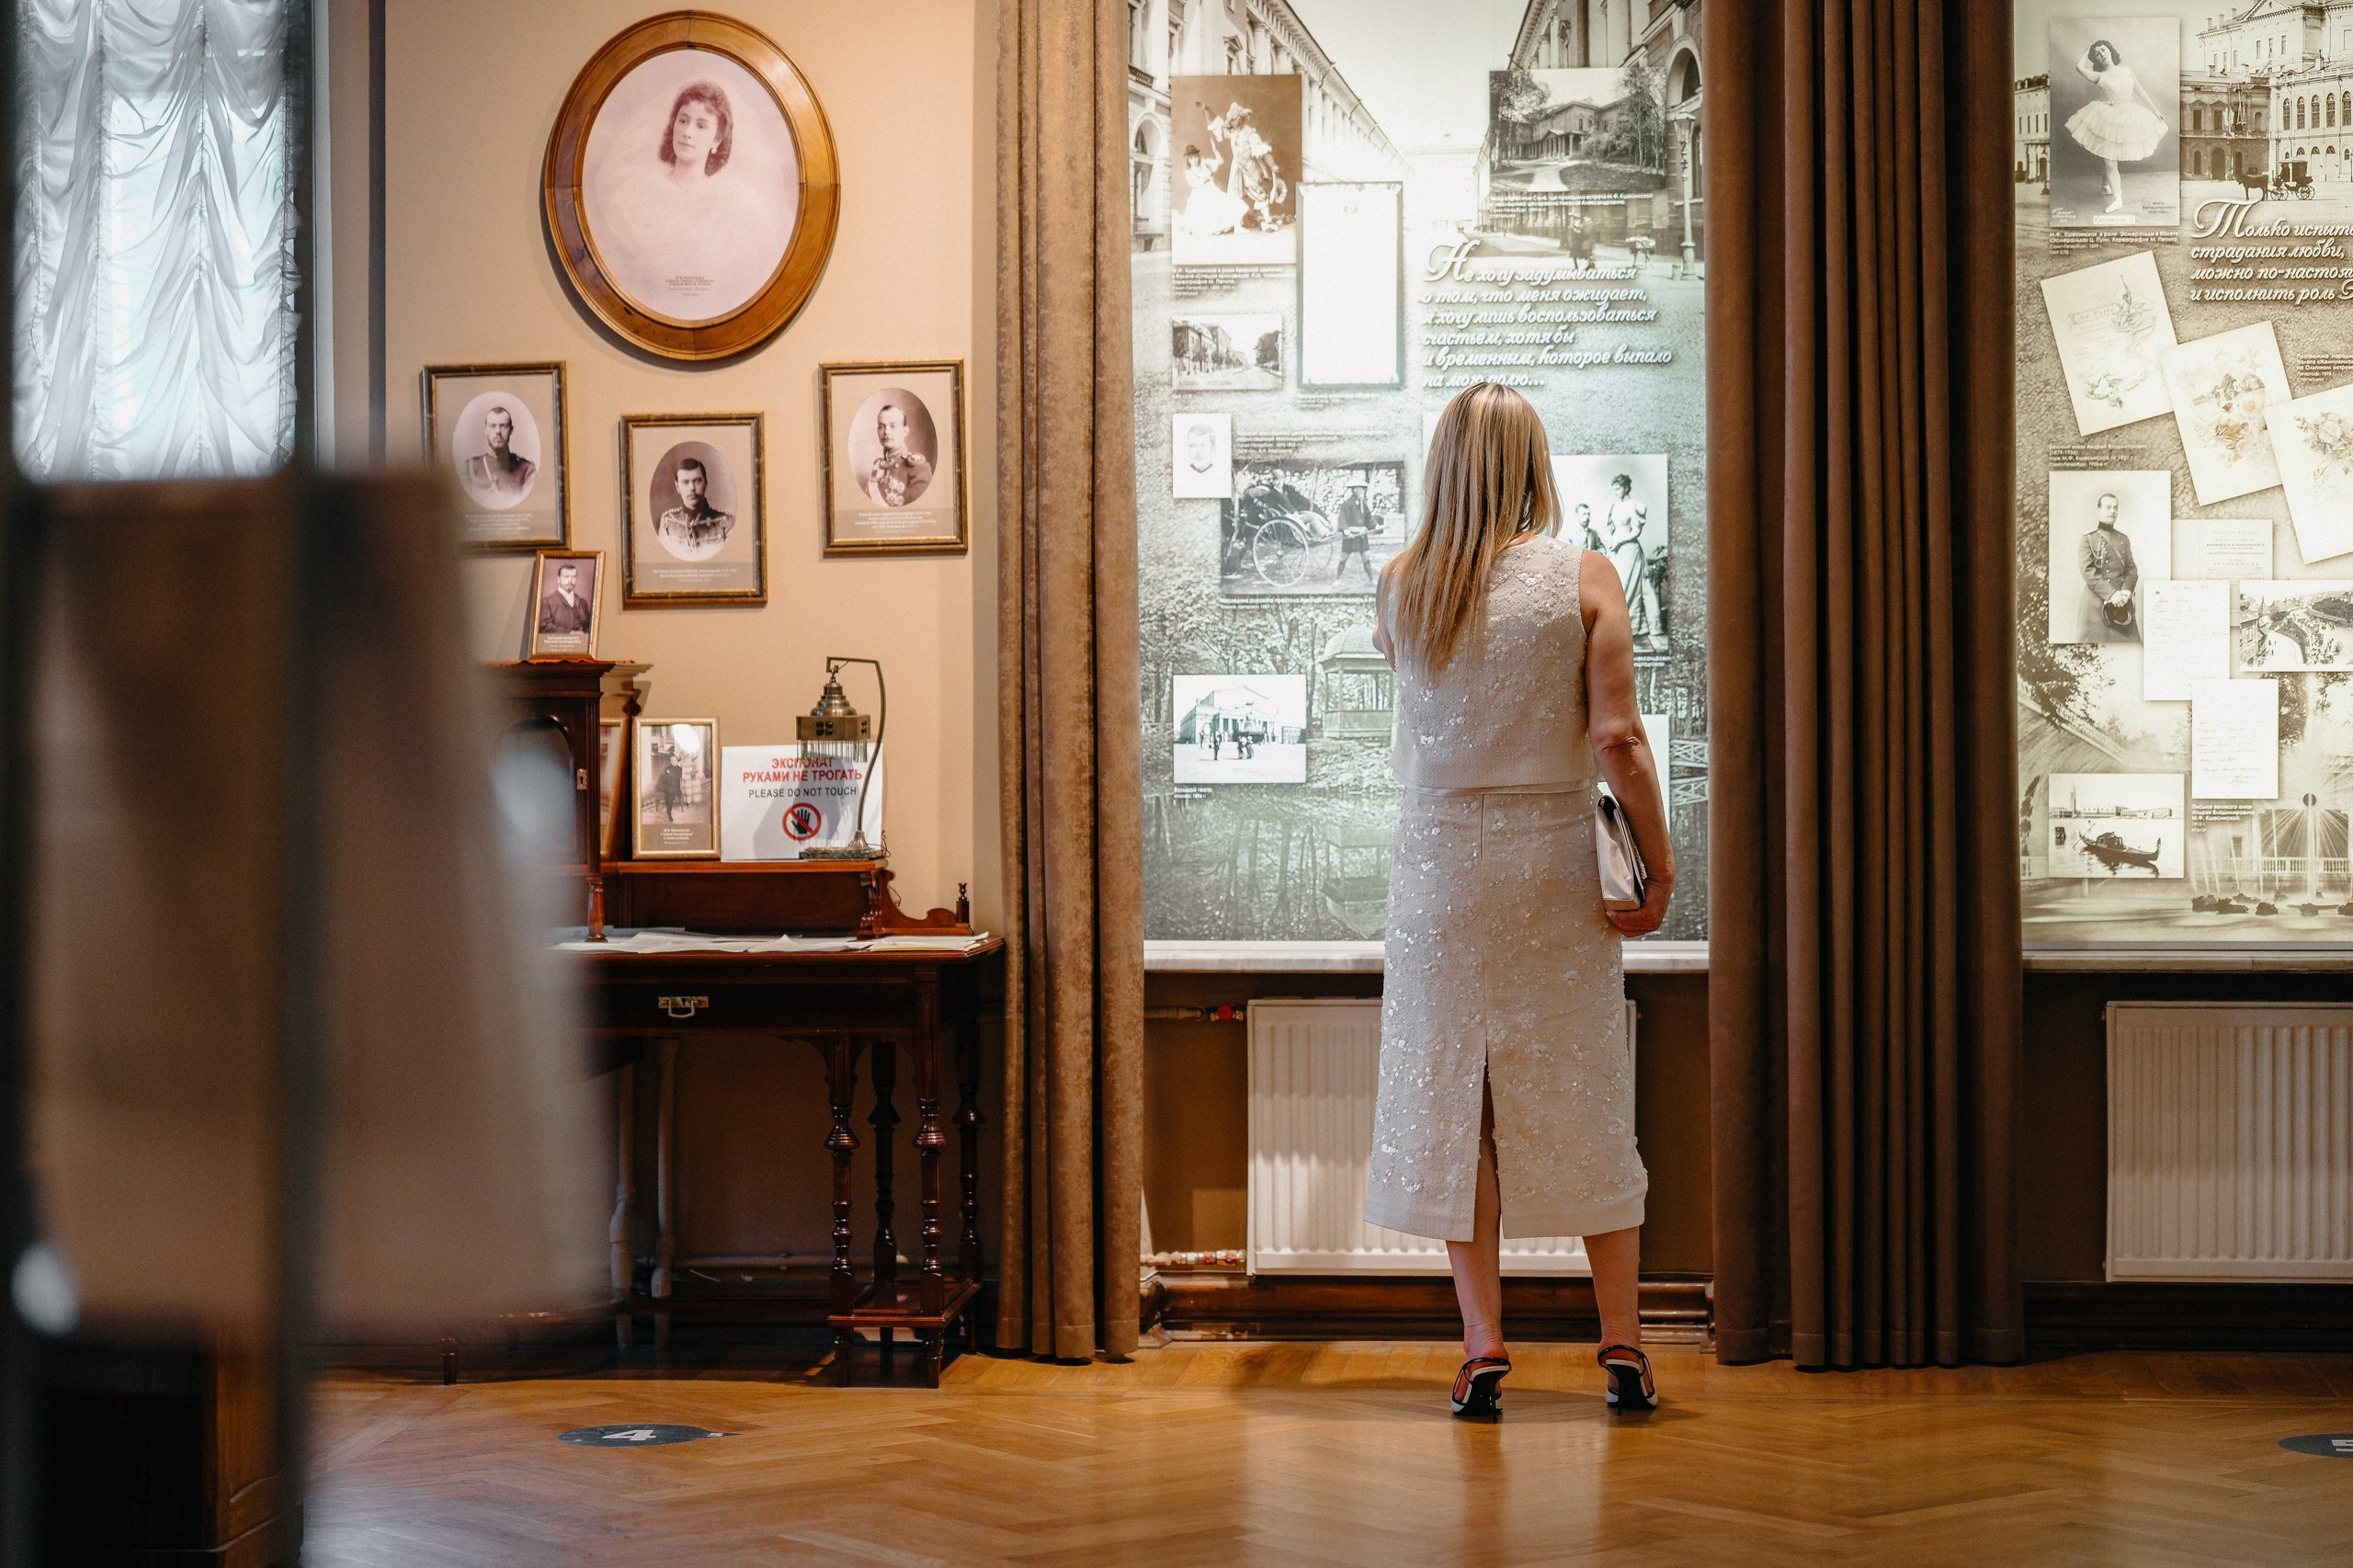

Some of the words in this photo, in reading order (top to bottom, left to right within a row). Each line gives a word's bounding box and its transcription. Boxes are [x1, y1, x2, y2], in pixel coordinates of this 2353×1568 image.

[2191, 198, 2290, 238] Только
[2191, 245, 2288, 264] страдания
[2289, 237, 2345, 259] любви,
[1424, 240, 1480, 282] Не
[1516, 265, 1638, 287] задумываться
[2191, 267, 2254, 279] можно
[1436, 291, 1478, 307] том,
[1517, 290, 1561, 303] меня
[1563, 289, 1647, 306] ожидает,
[2190, 289, 2201, 301] и
[2205, 288, 2295, 301] исполнить
[2297, 288, 2336, 305] роль
[1518, 304, 1656, 324] воспользоваться
[1506, 329, 1551, 346] хотя
[1554, 324, 1574, 345] бы
[1437, 347, 1535, 371] временным,
[1538, 346, 1610, 369] которое
[1614, 345, 1673, 365] выпало
[743, 771, 790, 783] РУКАМИ
[793, 770, 808, 781] НЕ
[812, 770, 862, 781] ТРОГАТЬ
[748, 789, 785, 798] PLEASE
[787, 788, 801, 797] DO
[803, 788, 823, 797] NOT
[825, 786, 857, 797] TOUCH
[602, 1429, 656, 1441] 4
